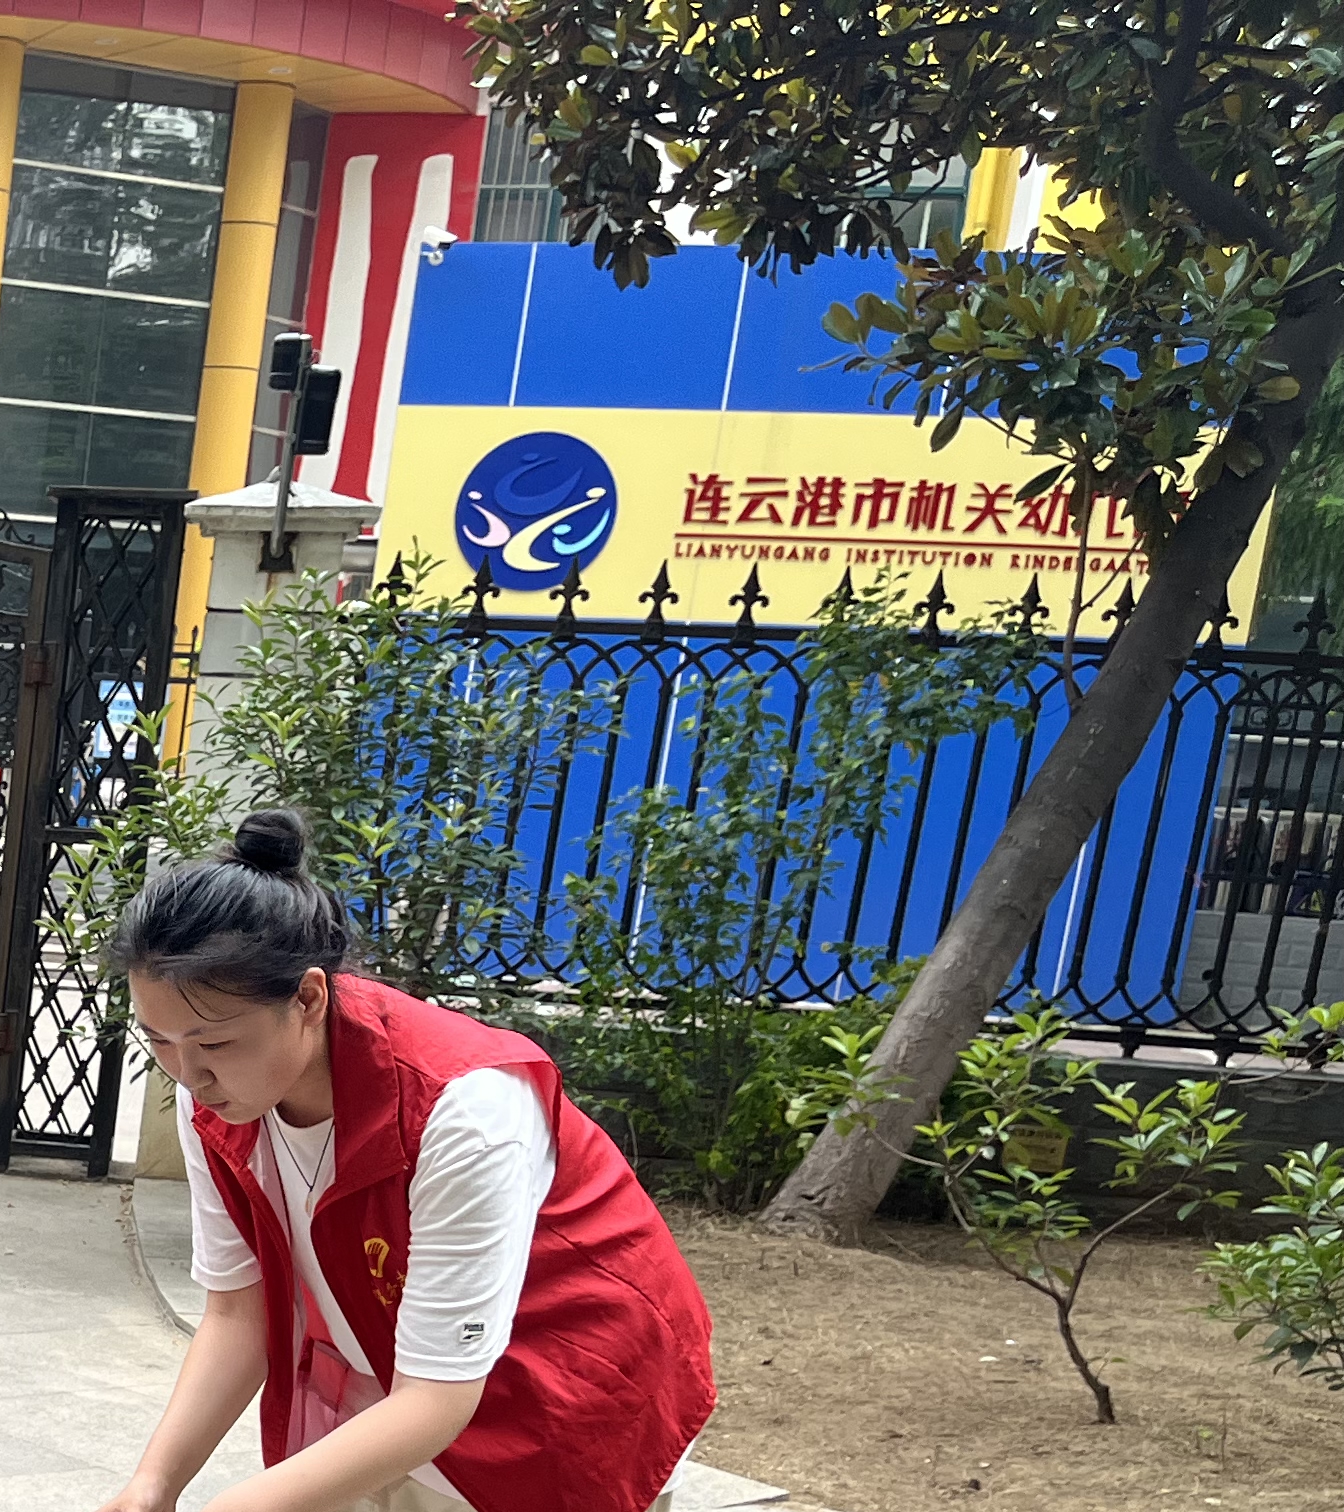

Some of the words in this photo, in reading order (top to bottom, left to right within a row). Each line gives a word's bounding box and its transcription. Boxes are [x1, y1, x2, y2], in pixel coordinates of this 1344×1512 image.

[682, 473, 1194, 540] 连云港市机关幼儿
[674, 542, 831, 562] LIANYUNGANG
[845, 548, 994, 567] INSTITUTION
